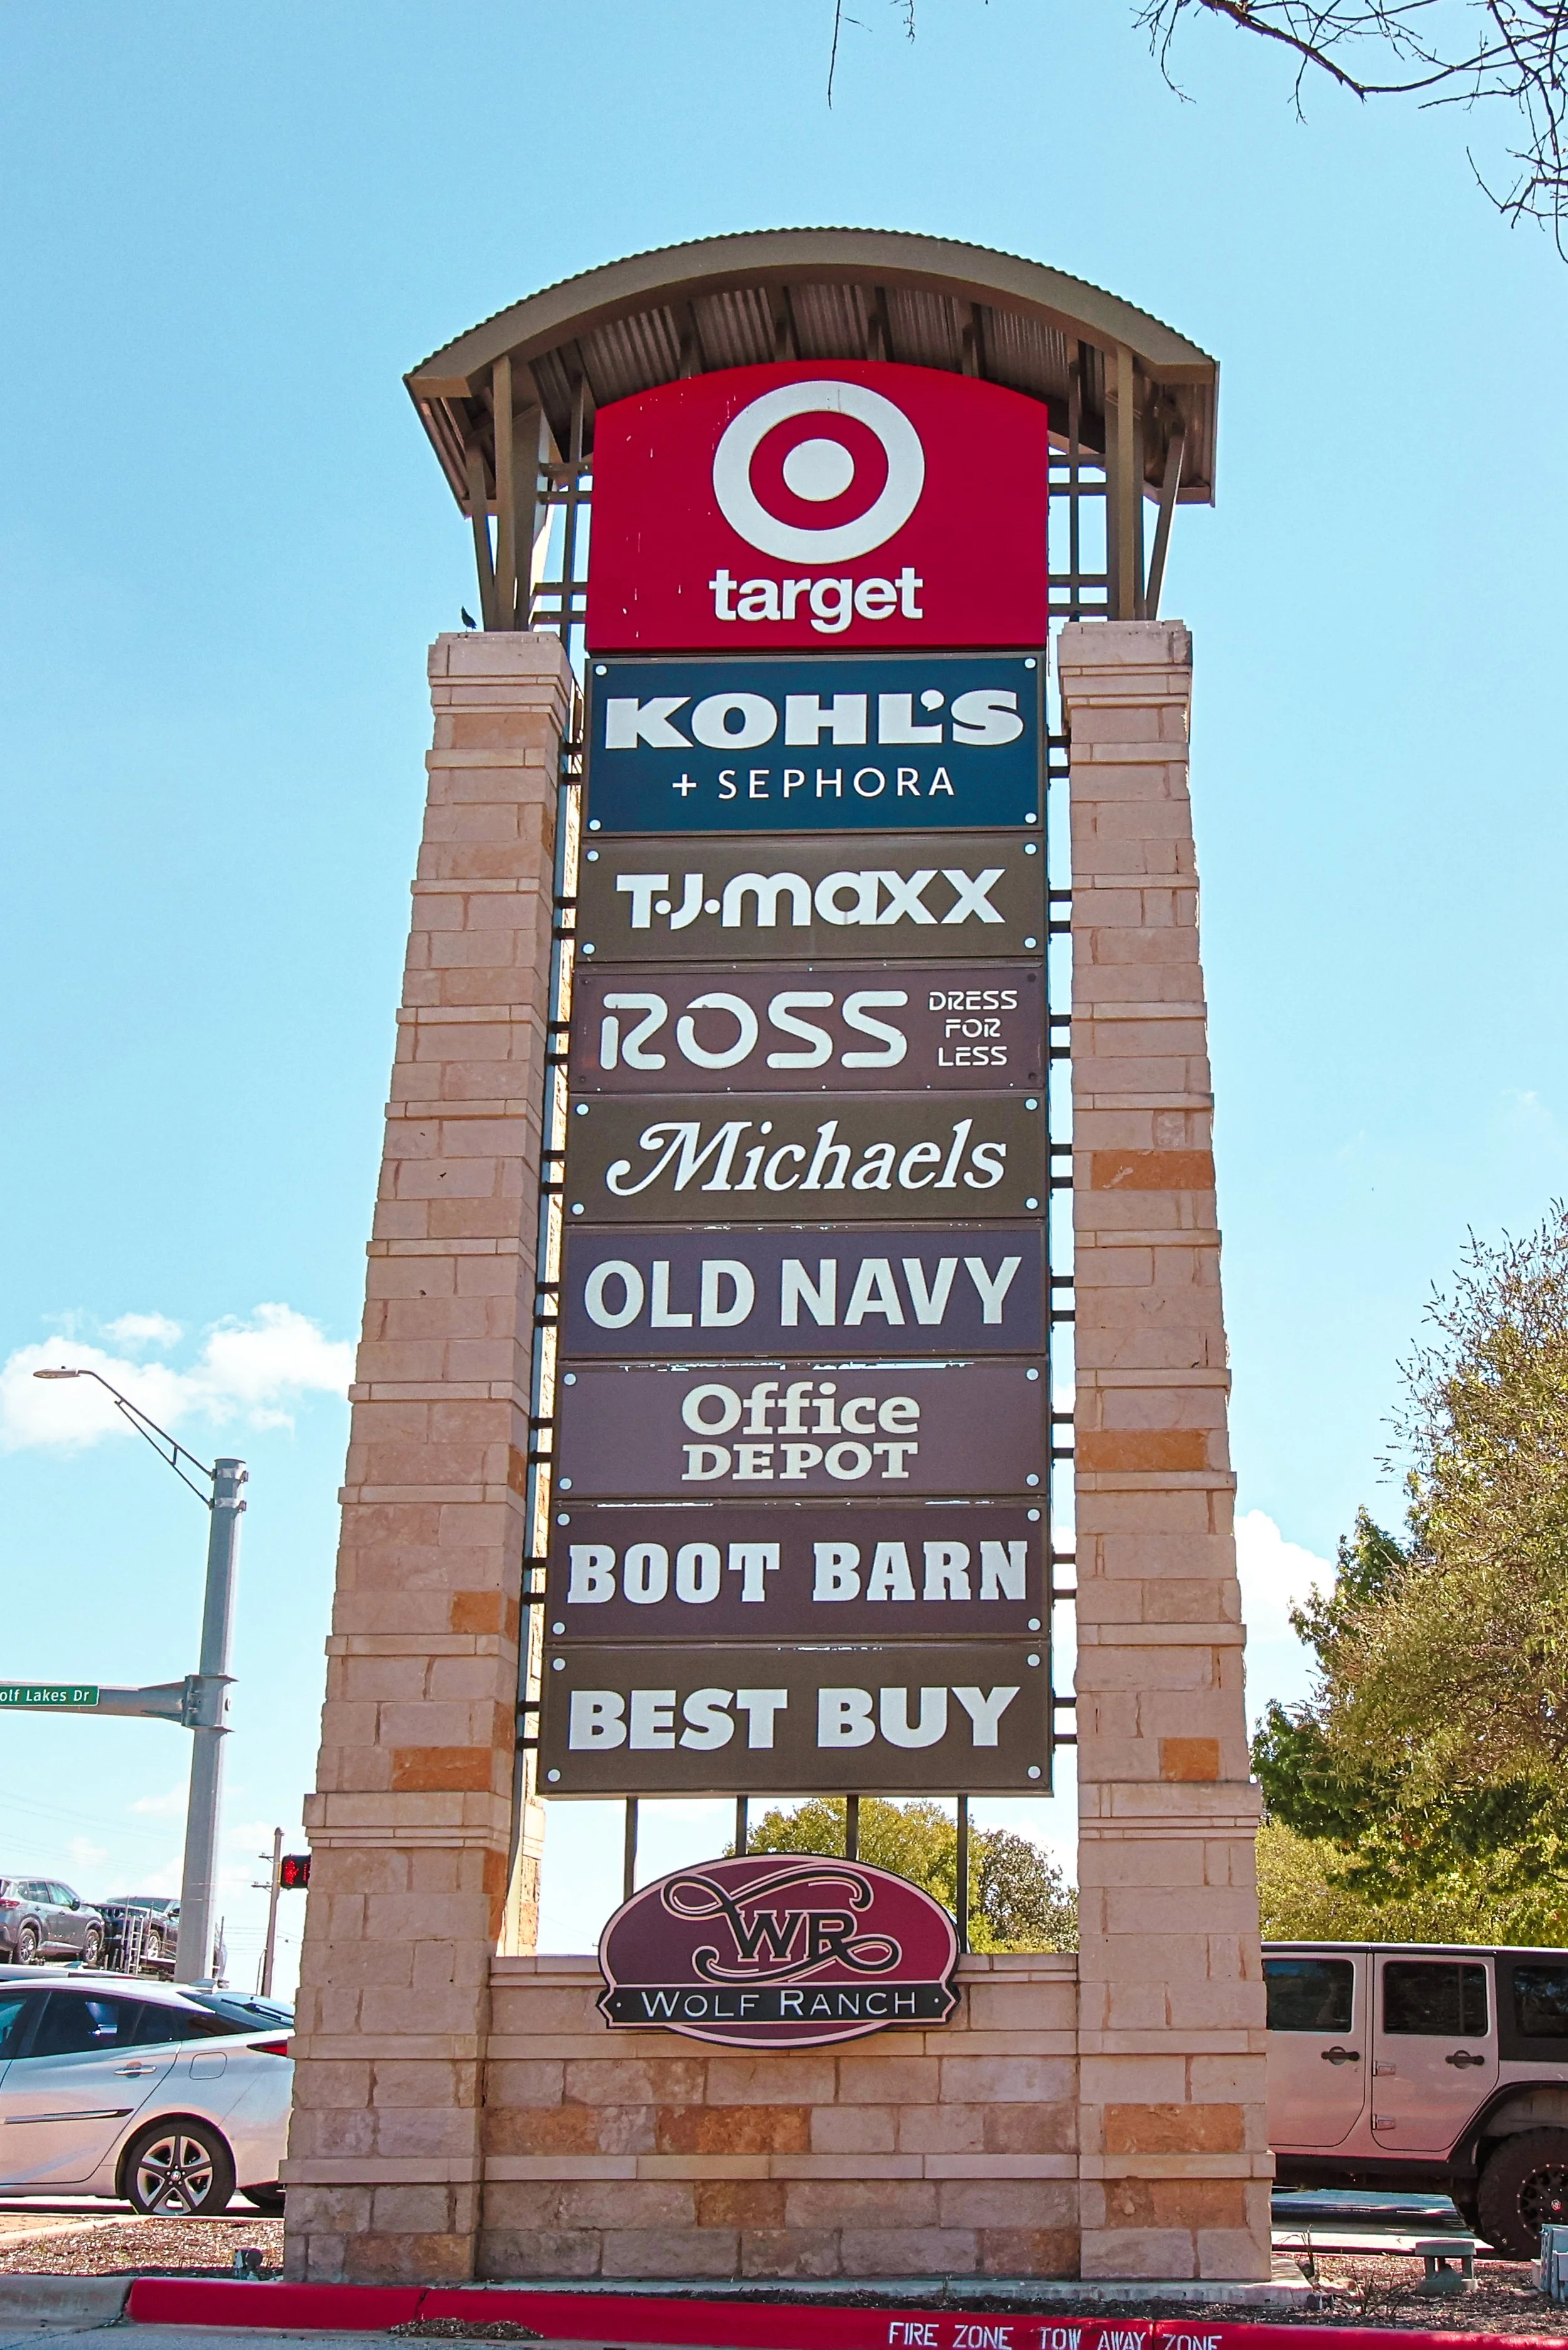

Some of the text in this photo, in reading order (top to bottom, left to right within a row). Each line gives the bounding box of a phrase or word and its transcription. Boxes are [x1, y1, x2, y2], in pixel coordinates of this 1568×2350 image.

[709, 567, 924, 634] target
[605, 689, 1024, 750] KOHL'S
[718, 767, 955, 800] SEPHORA
[930, 991, 1018, 1011] DRESS
[599, 991, 909, 1070] ROSS
[945, 1019, 1001, 1039] FOR
[938, 1046, 1008, 1067] LESS
[605, 1119, 1007, 1196] Michaels
[584, 1257, 1022, 1329] OLD NAVY
[681, 1381, 920, 1436] Office
[681, 1442, 919, 1481] DEPOT
[567, 1540, 1028, 1604] BOOT BARN
[26, 1689, 67, 1702] Lakes
[73, 1689, 90, 1702] Dr
[568, 1686, 1020, 1751] BEST BUY
[640, 1990, 917, 2018] WOLF RANCH
[889, 2322, 940, 2347] FIRE
[952, 2324, 1014, 2350] ZONE
[1040, 2327, 1082, 2350] TOW
[1098, 2330, 1147, 2350] AWAY
